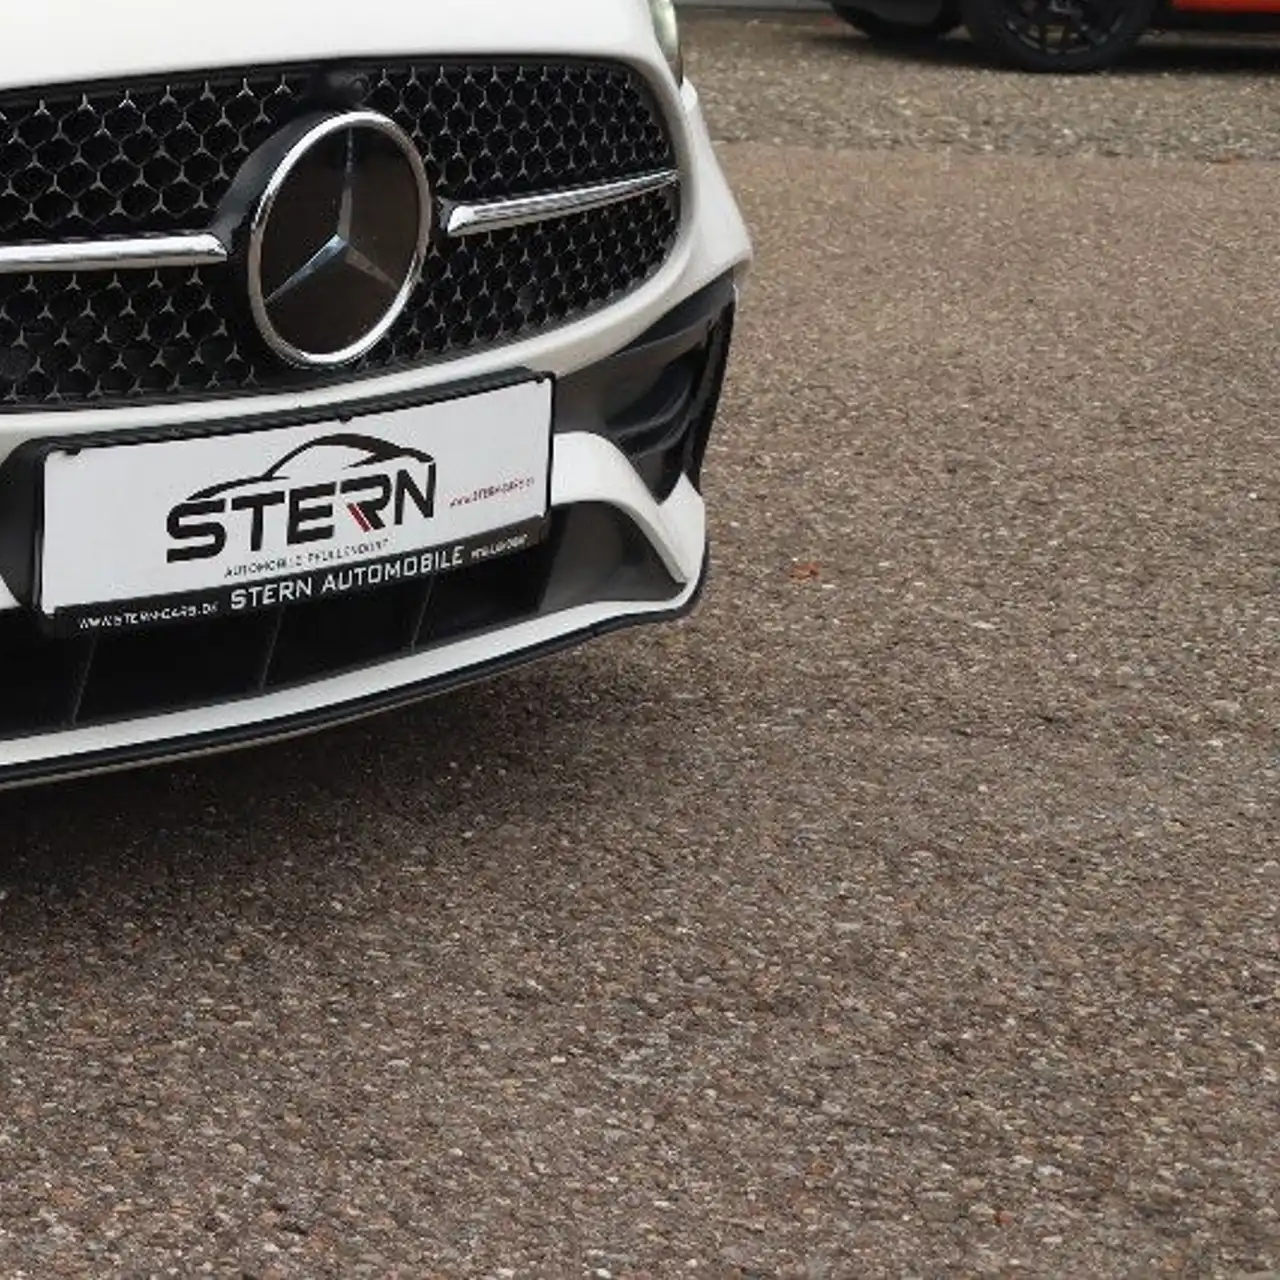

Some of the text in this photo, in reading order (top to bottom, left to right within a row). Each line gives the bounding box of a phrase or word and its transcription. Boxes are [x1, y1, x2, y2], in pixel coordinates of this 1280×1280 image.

[167, 463, 435, 563] STERN
[231, 577, 312, 610] STERN
[321, 546, 465, 594] AUTOMOBILE
